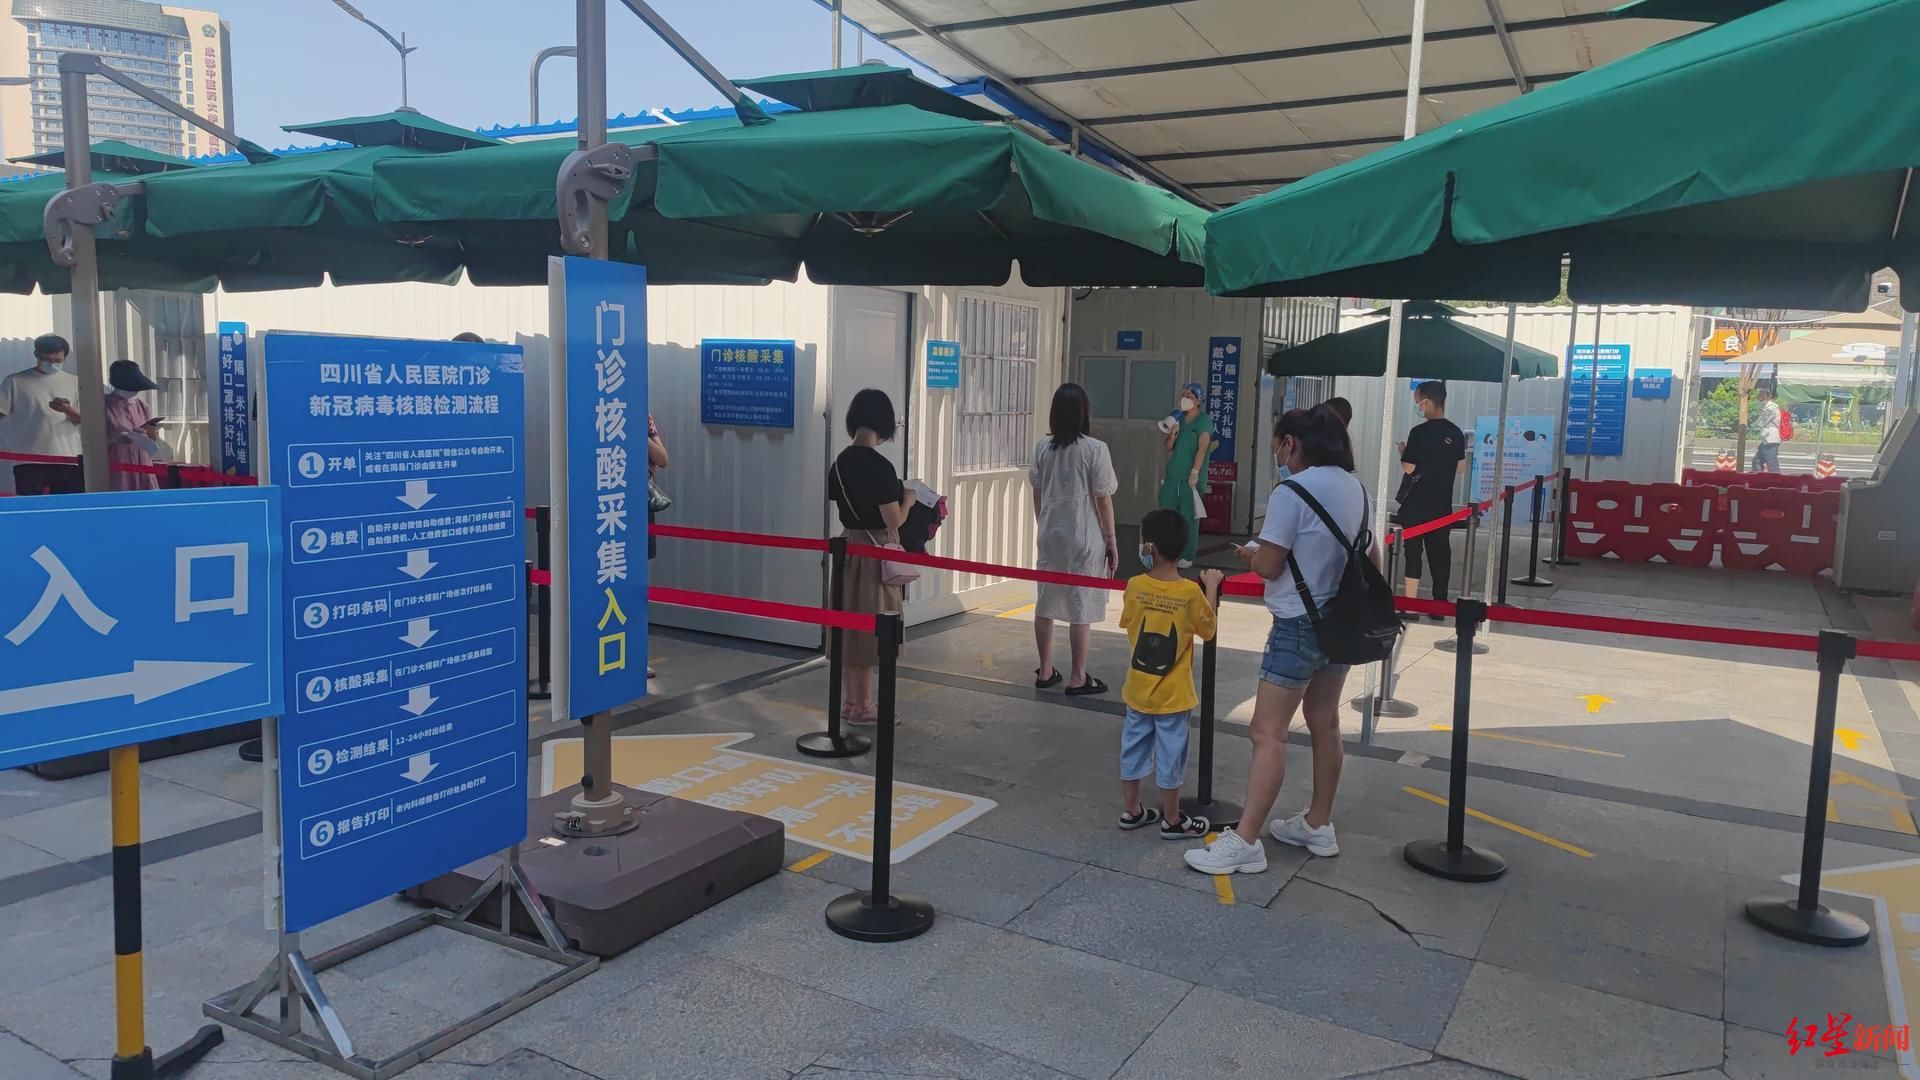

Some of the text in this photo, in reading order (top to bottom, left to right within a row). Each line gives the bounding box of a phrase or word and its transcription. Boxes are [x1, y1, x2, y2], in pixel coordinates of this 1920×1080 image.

[711, 348, 784, 364] 门诊核酸采集
[320, 362, 491, 386] 四川省人民医院门诊
[221, 336, 235, 457] 戴好口罩排好队
[309, 395, 500, 417] 新冠病毒核酸检测流程
[1221, 364, 1236, 438] 隔一米不扎堆
[234, 360, 247, 464] 隔一米不扎堆
[328, 456, 357, 472] 开单
[364, 459, 458, 474] 或者在简易门诊由医生开单
[594, 299, 627, 676] 门诊核酸采集入口
[330, 529, 359, 546] 缴费
[4, 542, 249, 646] 入口
[332, 599, 388, 620] 打印条码
[334, 668, 389, 692] 核酸采集
[336, 738, 390, 764] 检测结果
[337, 806, 390, 836] 报告打印
